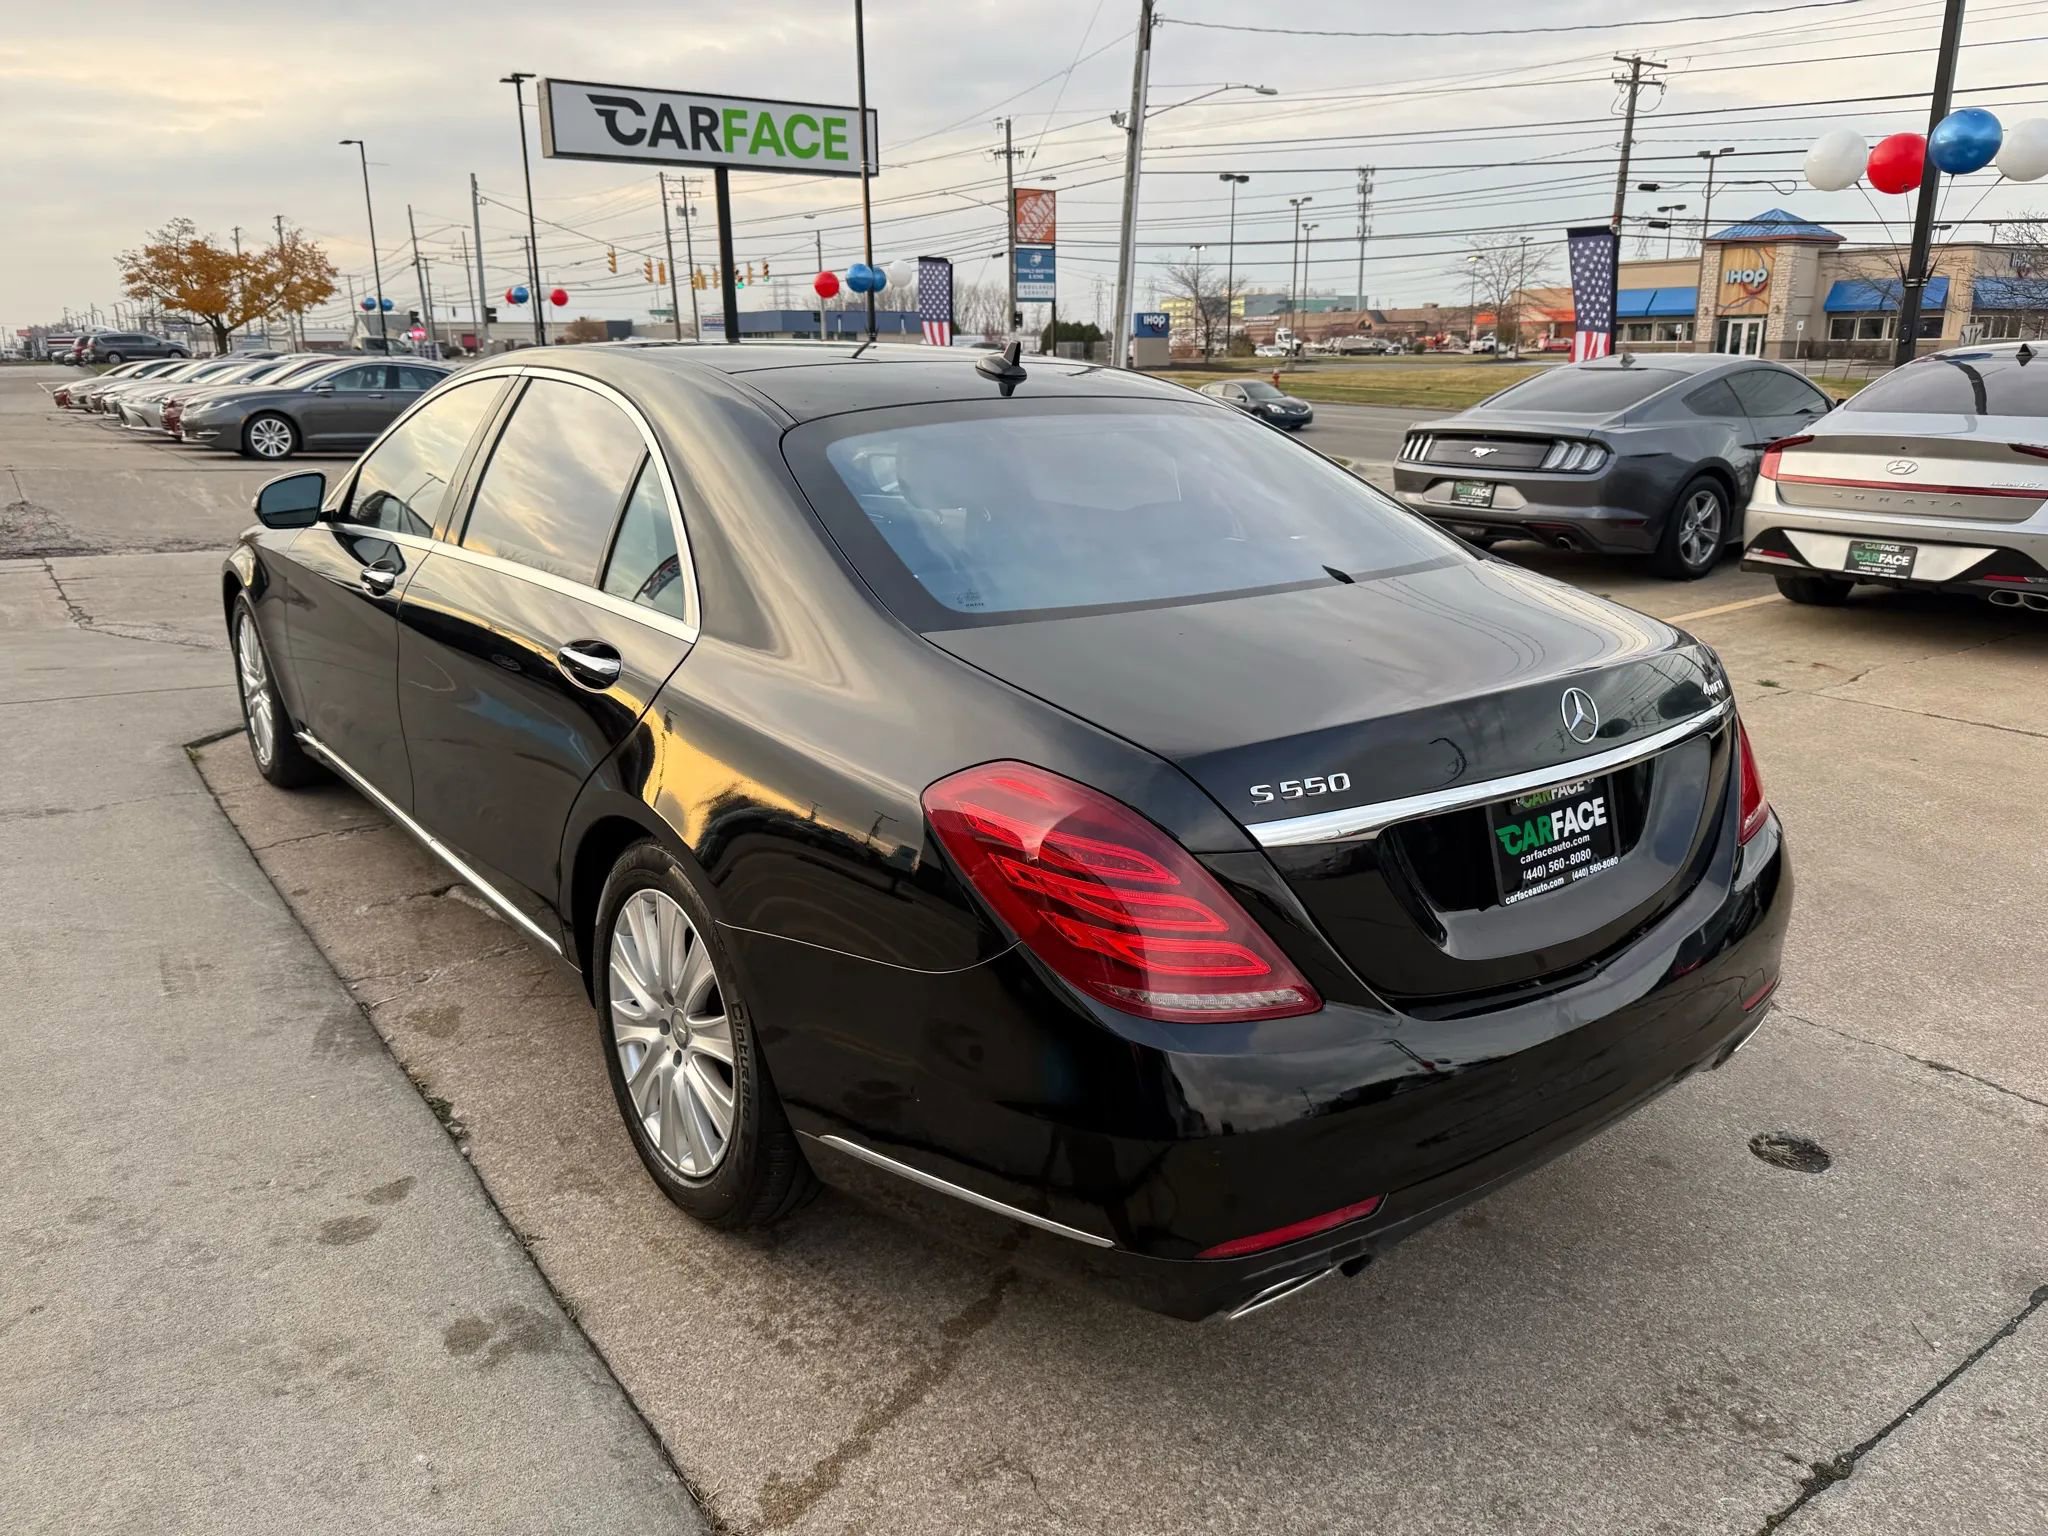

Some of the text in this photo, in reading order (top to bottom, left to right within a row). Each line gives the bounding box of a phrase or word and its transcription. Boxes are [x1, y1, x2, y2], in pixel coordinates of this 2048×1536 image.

[586, 93, 849, 161] CARFACE
[1725, 268, 1768, 288] IHOP
[1143, 315, 1166, 328] IHOP
[1852, 550, 1911, 566] CARFACE
[1250, 772, 1351, 806] S 550
[1495, 796, 1608, 855] CARFACE
[1520, 834, 1590, 864] carfaceauto.com
[1523, 864, 1547, 881] (440)
[1505, 876, 1565, 904] carfaceauto.com
